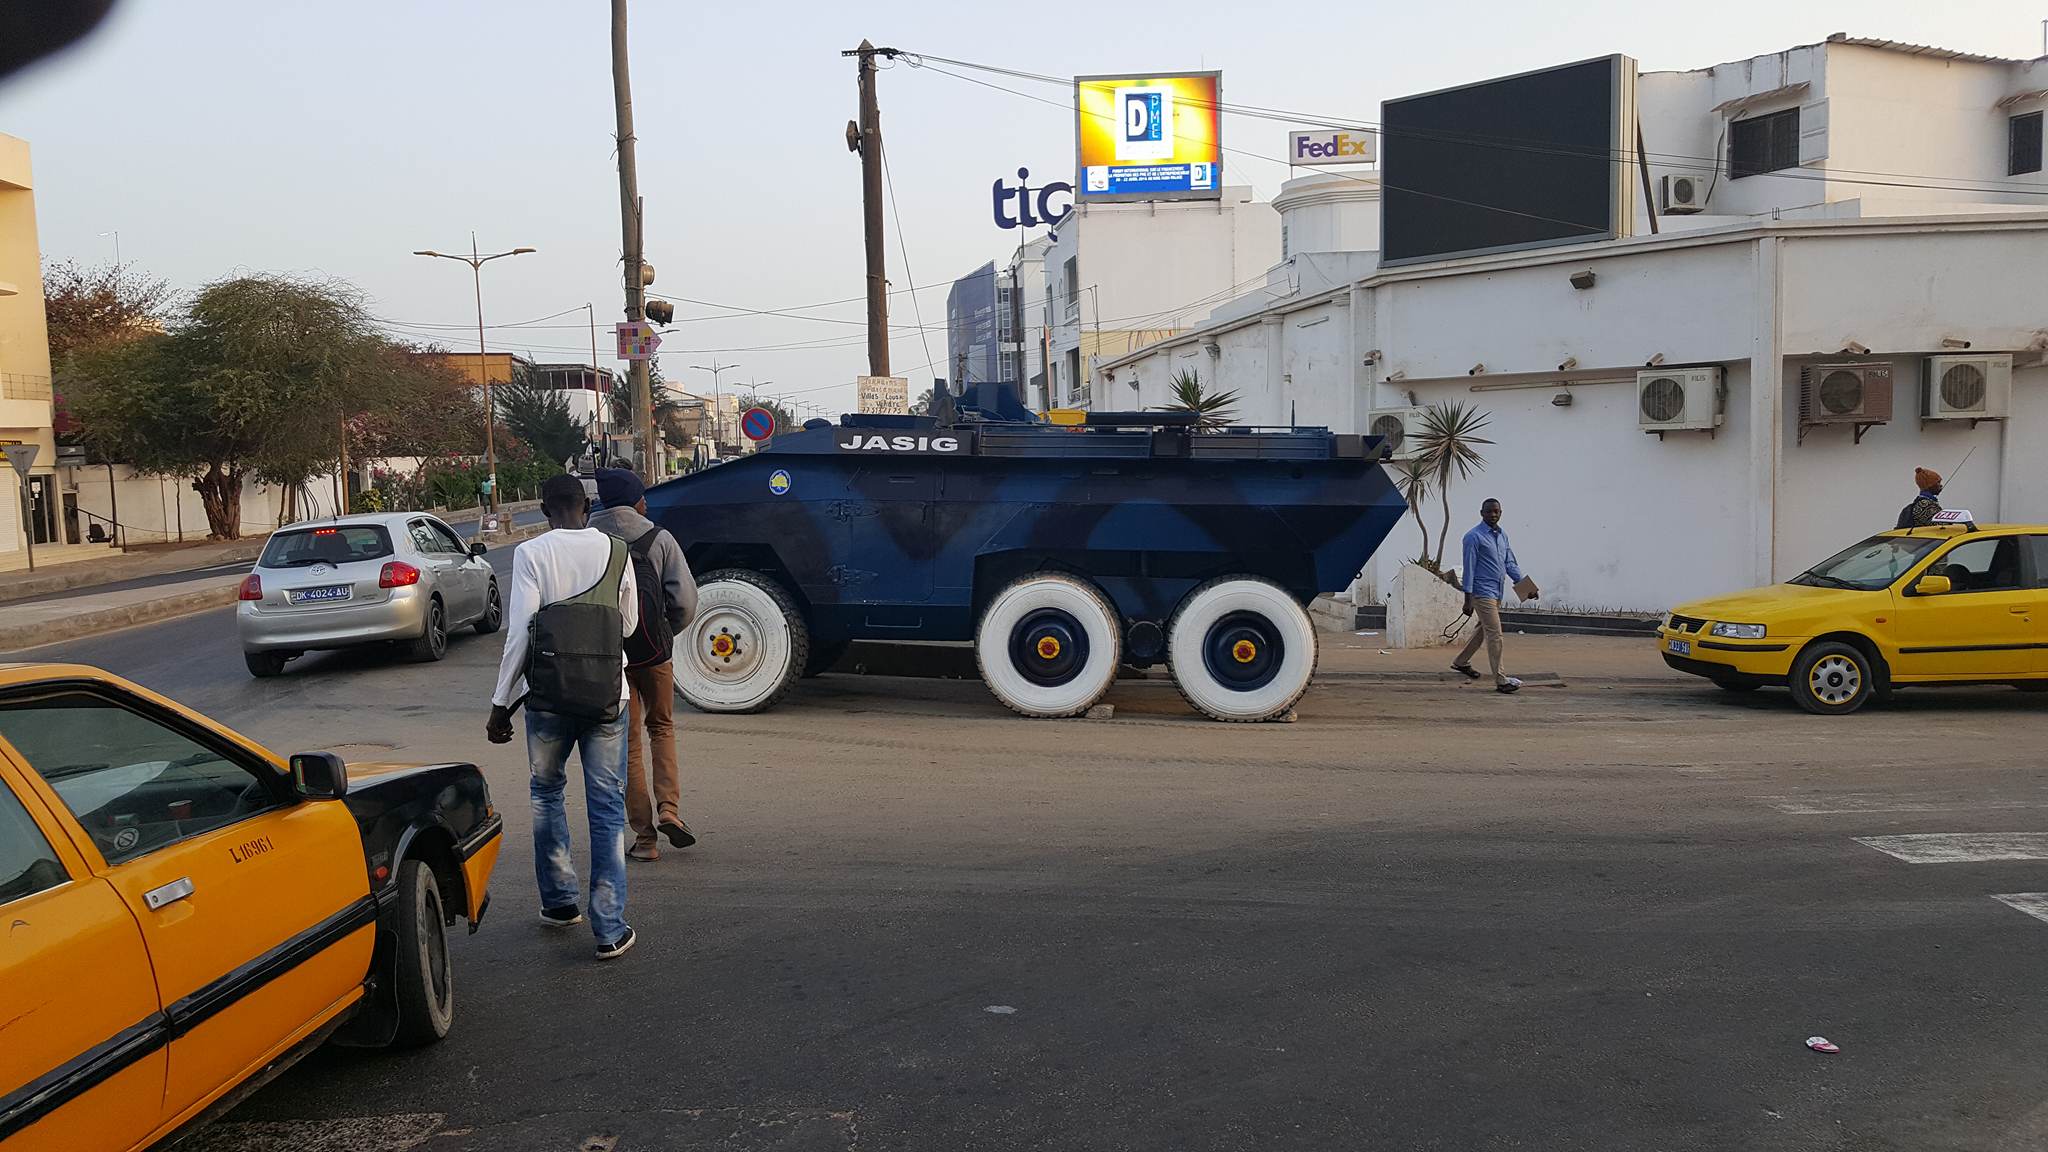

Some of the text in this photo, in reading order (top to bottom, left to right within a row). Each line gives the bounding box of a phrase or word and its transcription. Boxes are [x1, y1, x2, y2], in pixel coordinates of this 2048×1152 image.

[1128, 100, 1148, 136] D
[1297, 133, 1368, 158] FedEx
[840, 435, 958, 452] JASIG
[1937, 512, 1959, 520] TAXI
[296, 587, 348, 600] DK-4024-AU
[229, 835, 275, 864] L16961
